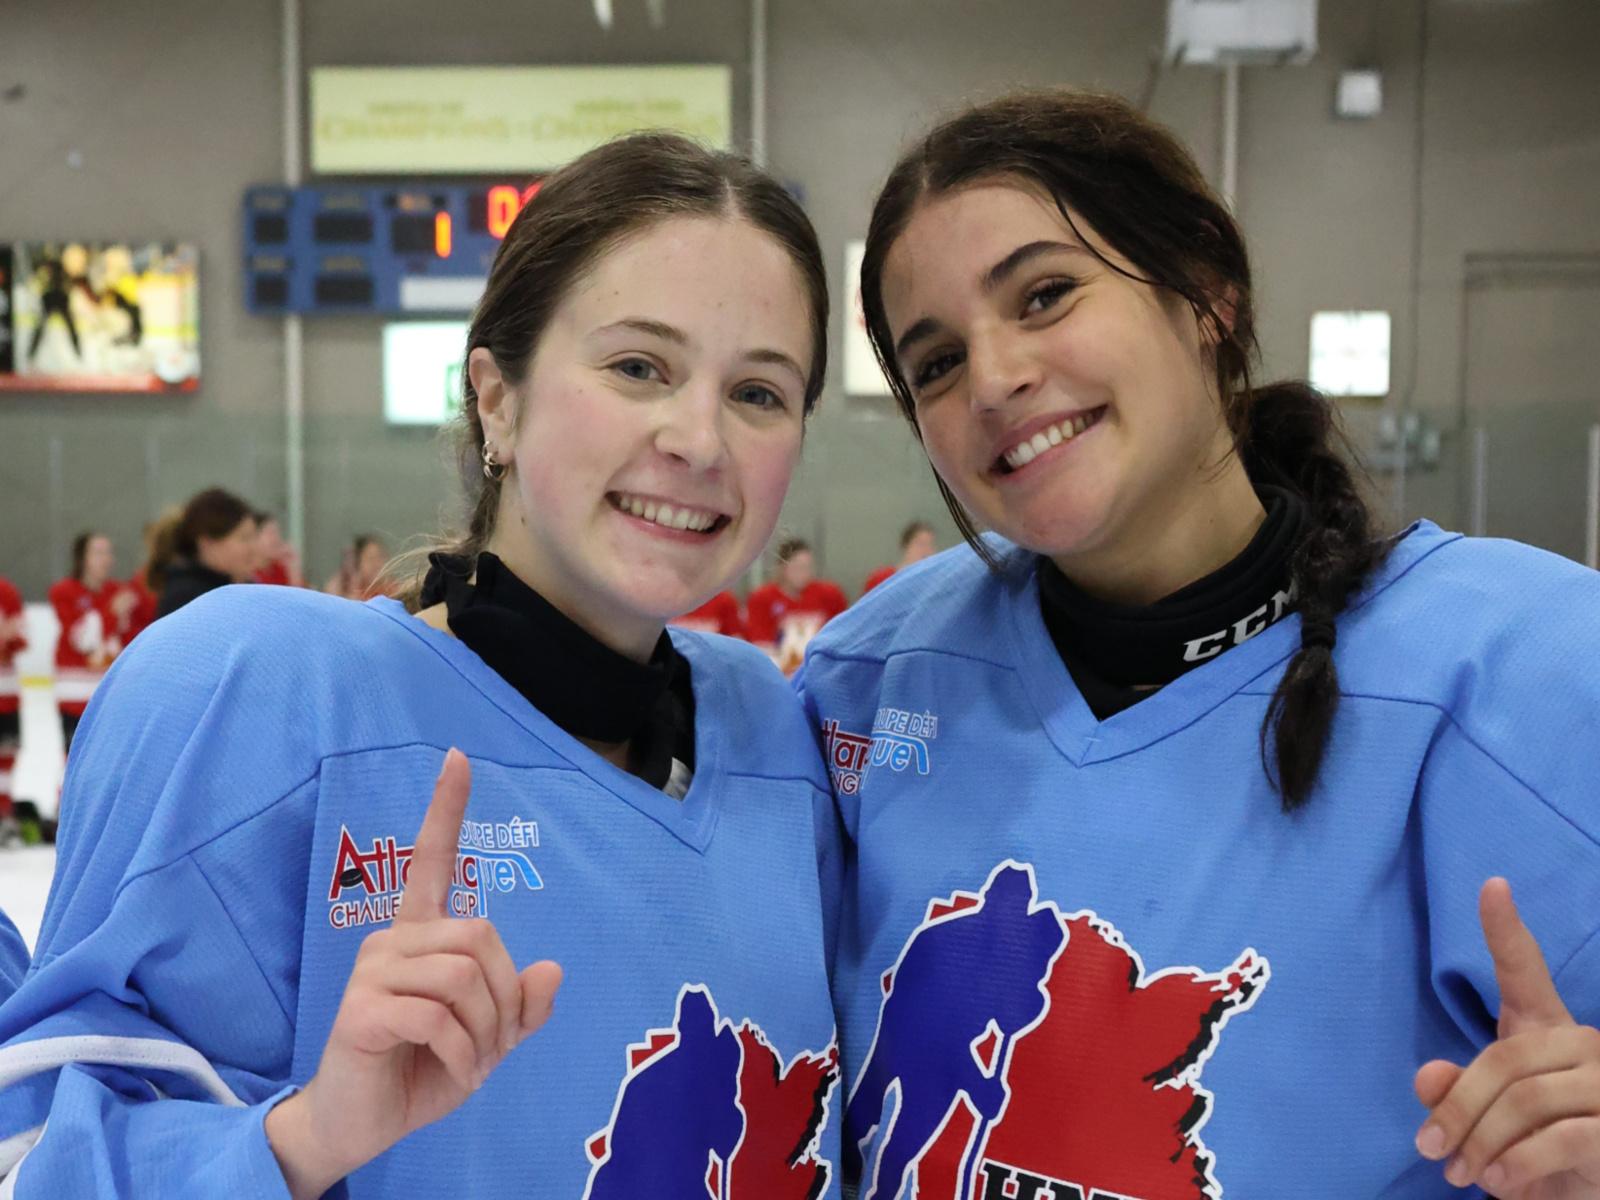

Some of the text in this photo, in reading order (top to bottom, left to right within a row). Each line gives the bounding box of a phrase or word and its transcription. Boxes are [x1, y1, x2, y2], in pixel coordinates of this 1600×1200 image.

[459, 816, 540, 848] OUPE DÉFI
[329, 890, 478, 929] CHALLE CUP
